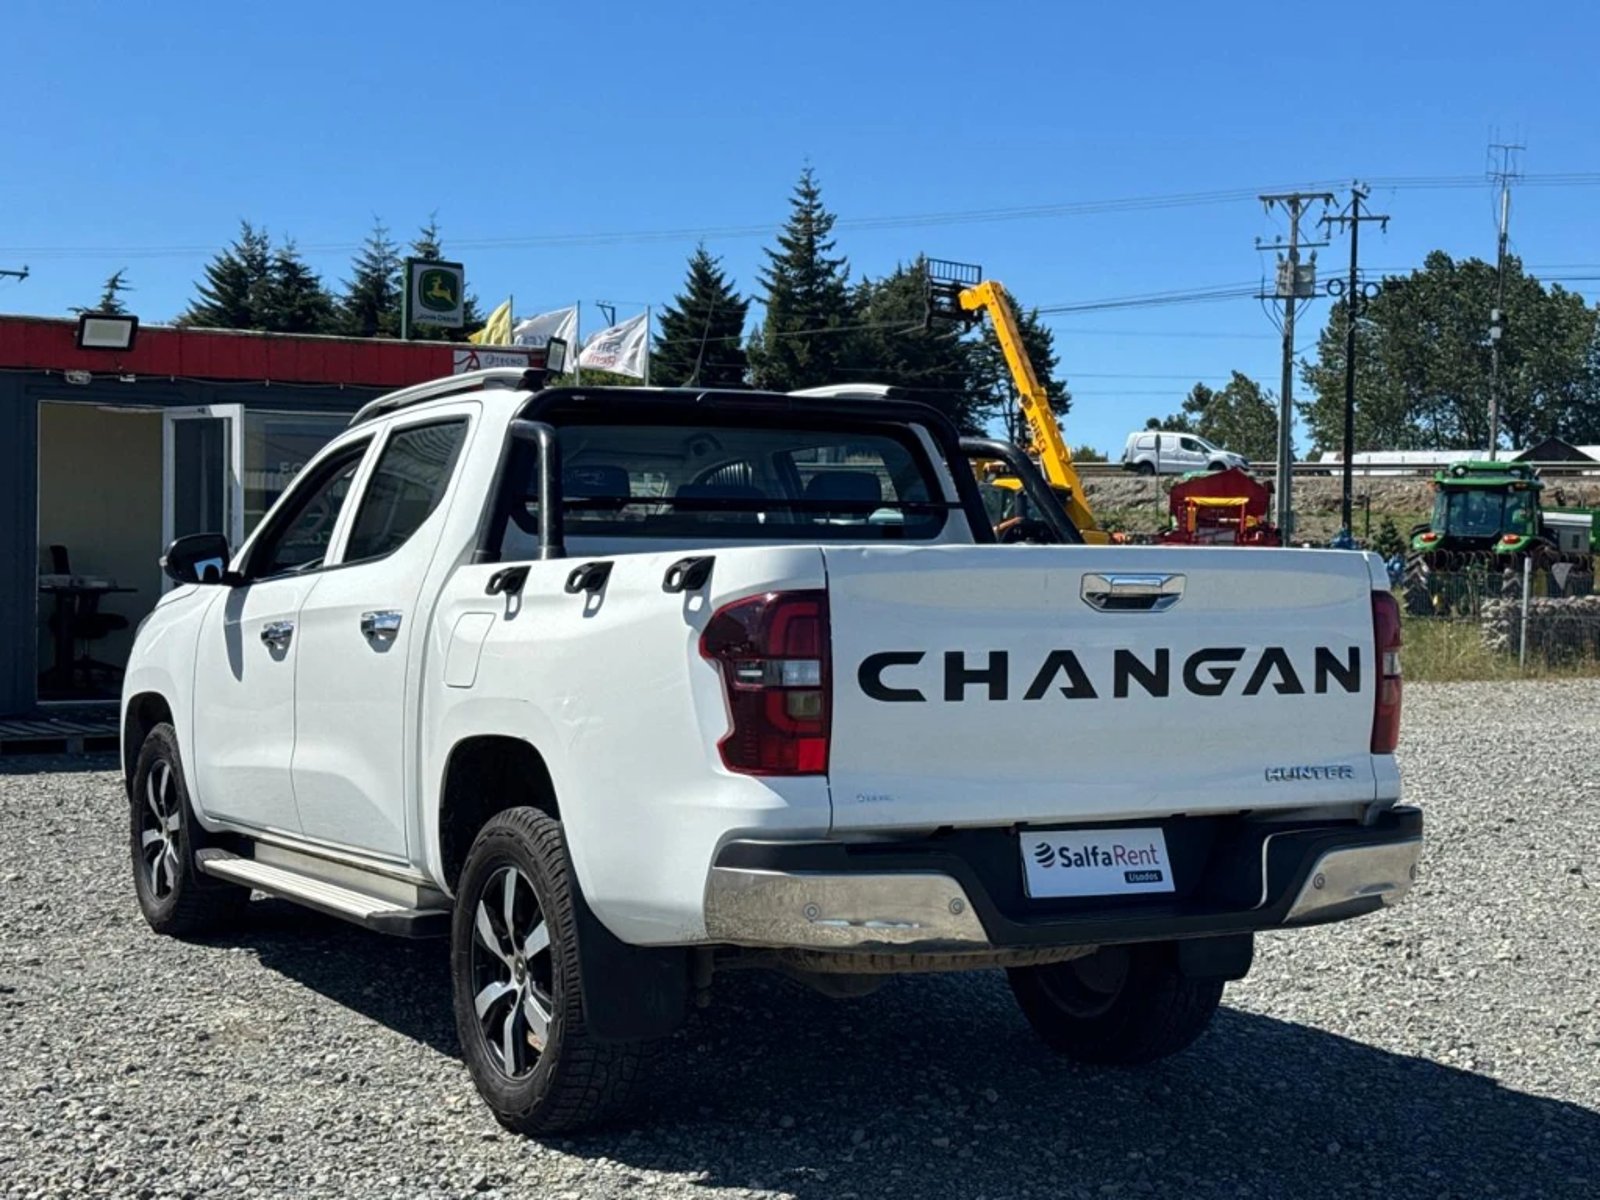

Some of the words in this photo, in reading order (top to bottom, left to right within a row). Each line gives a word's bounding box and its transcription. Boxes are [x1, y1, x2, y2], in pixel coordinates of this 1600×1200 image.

[857, 646, 1361, 702] CHANGAN
[1265, 765, 1355, 782] HUNTER
[1058, 843, 1160, 869] SalfaRent
[1128, 872, 1159, 882] Usados
